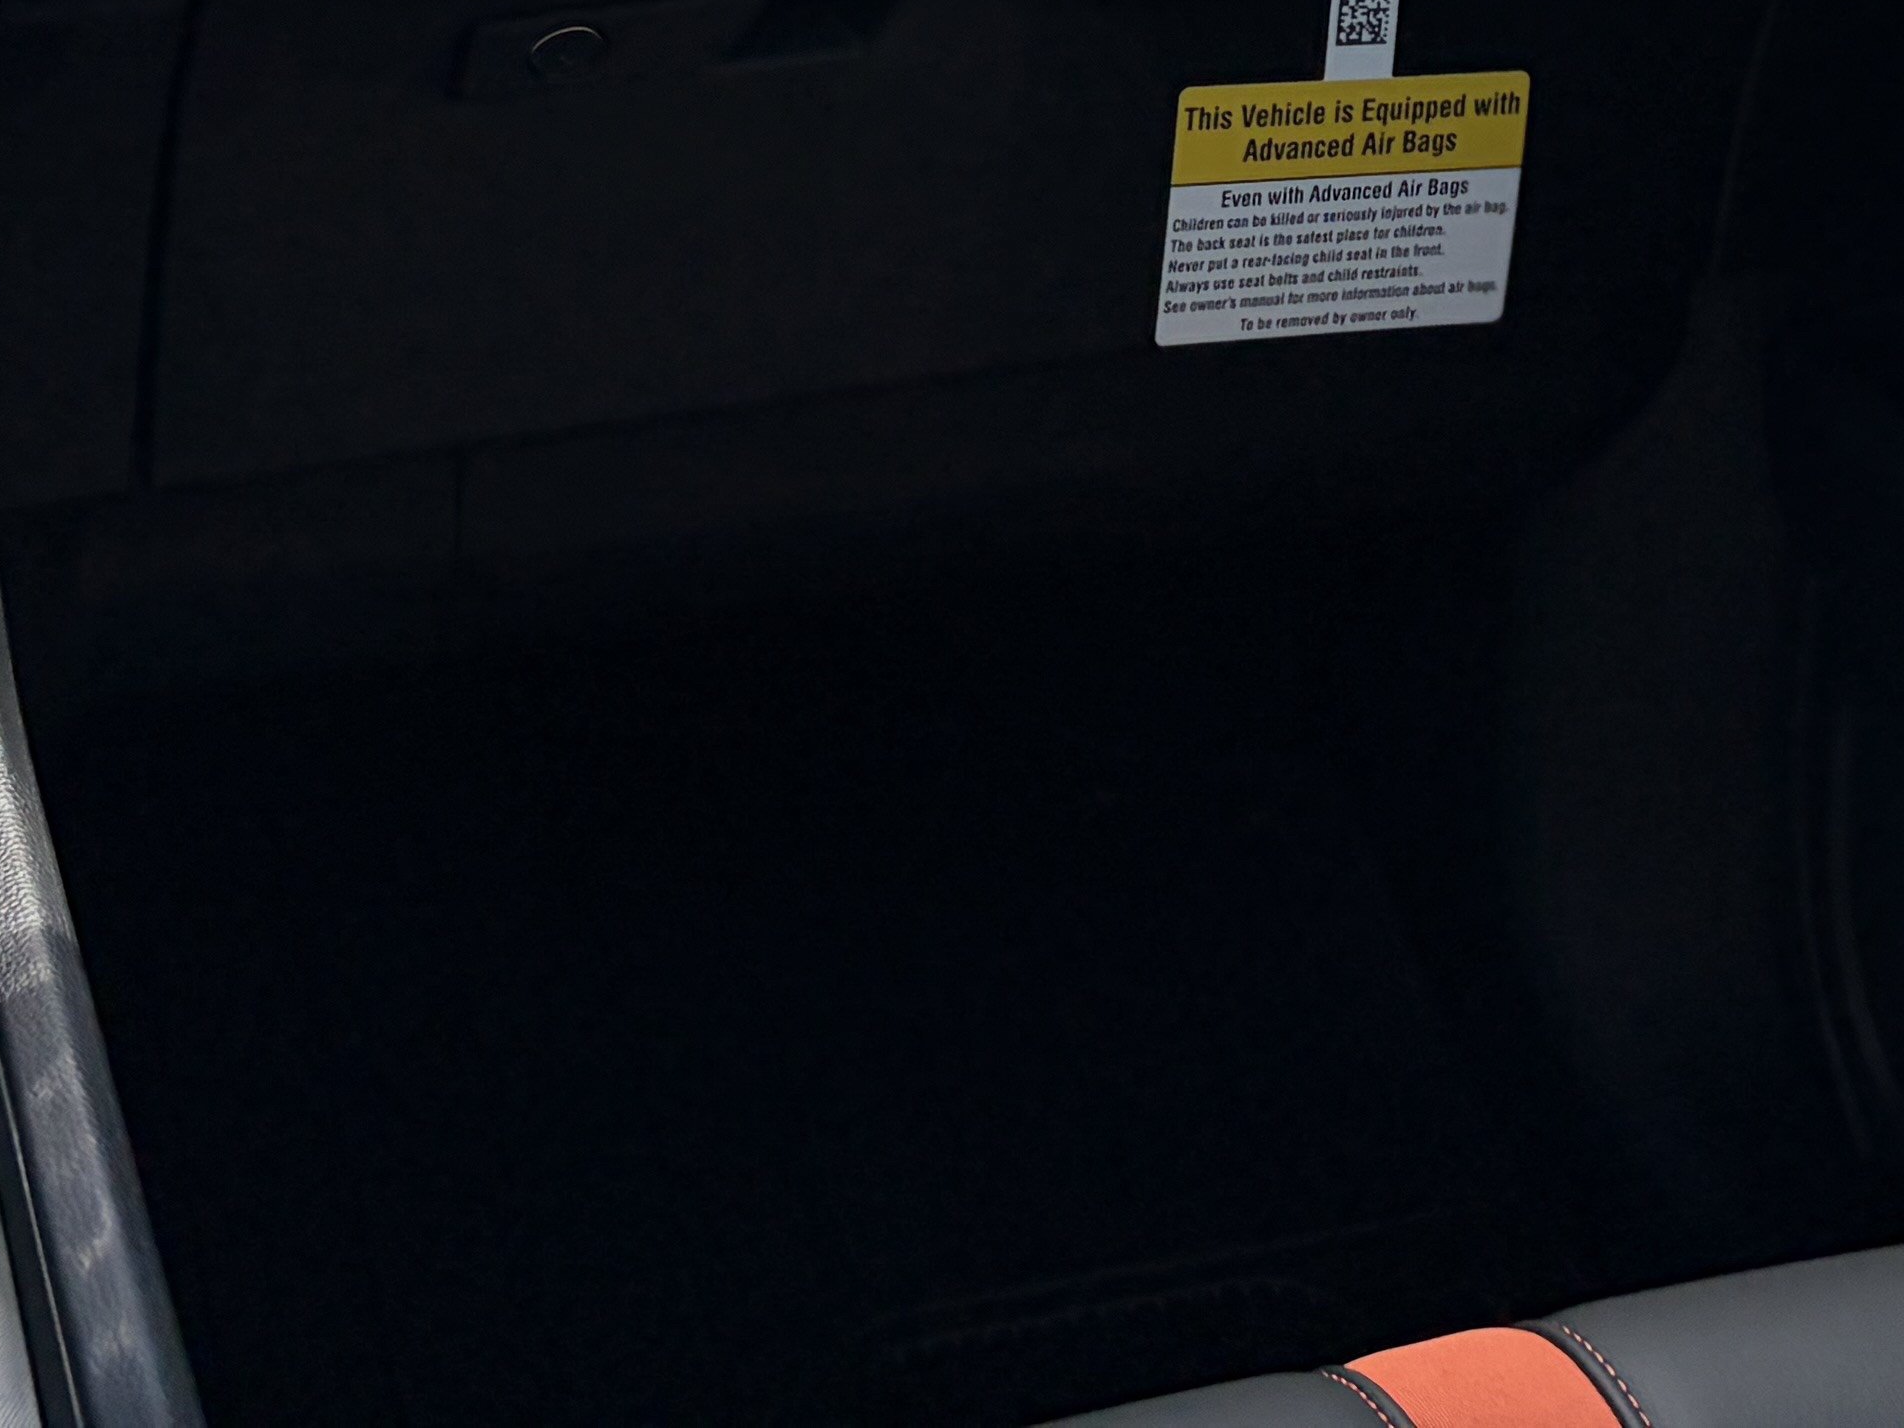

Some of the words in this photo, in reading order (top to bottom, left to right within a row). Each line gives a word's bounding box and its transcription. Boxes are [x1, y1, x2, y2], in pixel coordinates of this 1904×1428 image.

[1184, 105, 1233, 132] This
[1241, 99, 1326, 129] Vehicle
[1334, 100, 1355, 125] is
[1362, 94, 1467, 127] Equipped
[1474, 91, 1521, 118] with
[1242, 133, 1356, 163] Advanced
[1361, 131, 1396, 157] Air
[1402, 128, 1458, 158] Bags
[1221, 189, 1263, 209] Even
[1268, 185, 1304, 206] with
[1309, 180, 1393, 205] Advanced
[1398, 178, 1424, 199] Air
[1427, 177, 1470, 200] Bags
[1172, 216, 1225, 234] Children
[1226, 216, 1250, 230] can
[1252, 214, 1268, 228] be
[1270, 211, 1305, 226] killed
[1306, 212, 1321, 225] or
[1323, 205, 1378, 225] seriously
[1380, 203, 1424, 222] injured
[1426, 204, 1441, 219] by
[1443, 202, 1463, 216] the
[1464, 201, 1482, 214] air
[1170, 238, 1194, 254] The
[1196, 237, 1226, 253] back
[1228, 235, 1256, 250] seat
[1258, 234, 1271, 247] is
[1273, 232, 1293, 247] the
[1296, 230, 1334, 246] safest
[1335, 227, 1370, 245] place
[1373, 226, 1391, 241] for
[1167, 258, 1205, 274] Never
[1207, 257, 1228, 274] put
[1230, 257, 1239, 267] a
[1242, 252, 1311, 268] rear-facing
[1312, 249, 1344, 264] child
[1346, 246, 1373, 262] seat
[1376, 246, 1388, 260] in
[1390, 244, 1410, 259] the
[1165, 278, 1210, 295] Always
[1213, 278, 1235, 291] use
[1238, 274, 1266, 289] seat
[1268, 272, 1299, 287] belts
[1301, 270, 1326, 285] and
[1327, 266, 1359, 283] child
[1240, 317, 1254, 332] To
[1257, 316, 1273, 331] be
[1275, 312, 1330, 329] removed
[1331, 311, 1348, 326] by
[1350, 309, 1387, 324] owner
